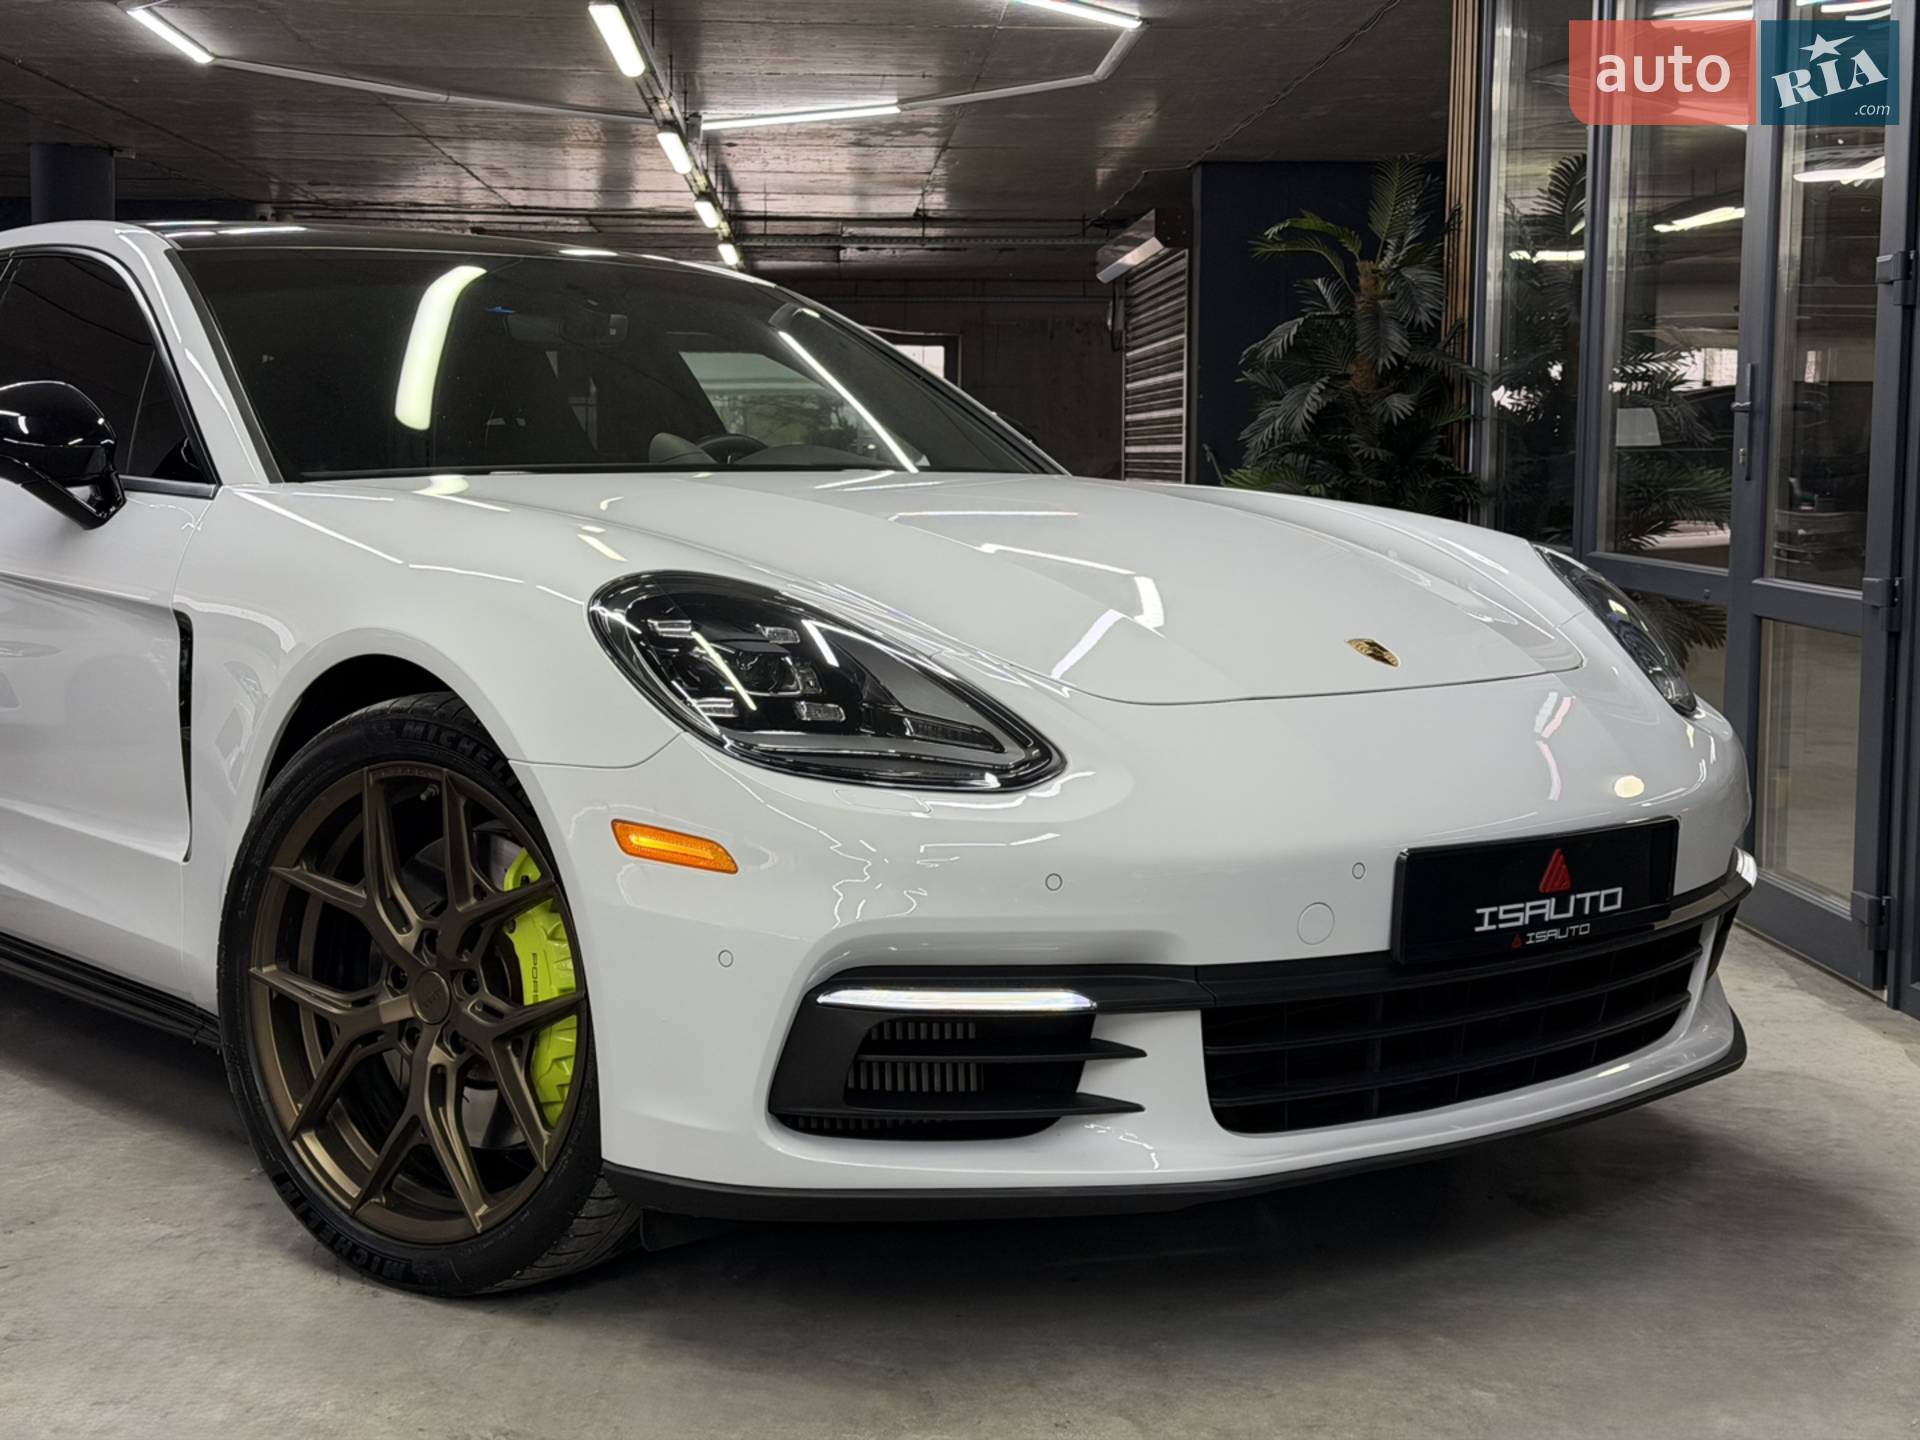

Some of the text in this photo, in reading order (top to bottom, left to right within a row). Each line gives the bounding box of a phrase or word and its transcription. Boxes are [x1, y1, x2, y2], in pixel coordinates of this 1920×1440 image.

[1475, 887, 1623, 932] ISAUTO
[1525, 923, 1591, 945] ISAUTO
[280, 1181, 406, 1282] MICHELIN
